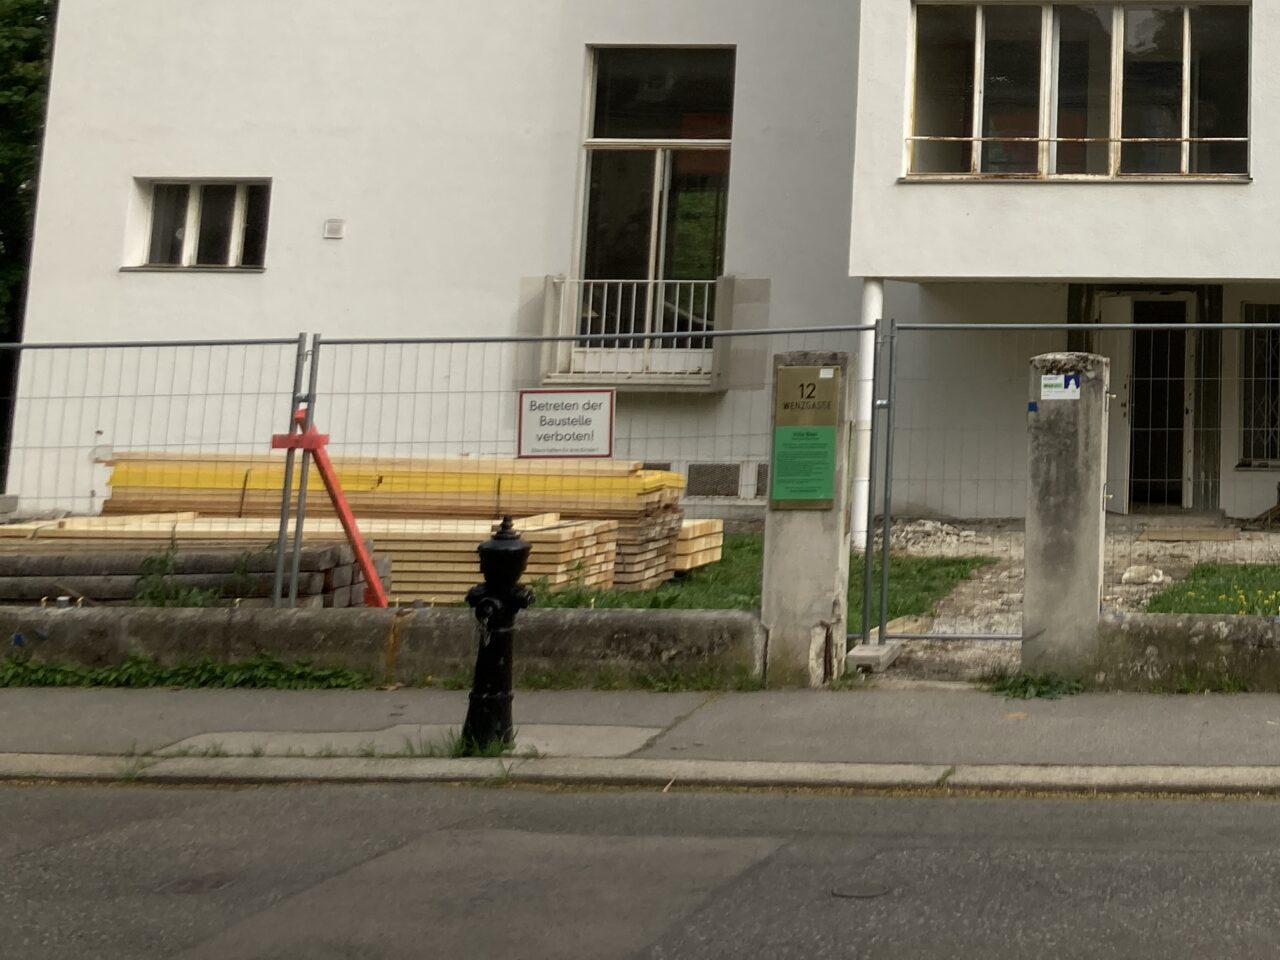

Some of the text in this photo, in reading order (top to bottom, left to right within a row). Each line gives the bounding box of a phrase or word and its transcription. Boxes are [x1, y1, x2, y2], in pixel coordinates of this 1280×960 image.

[799, 382, 816, 399] 12
[529, 400, 603, 411] Betreten der
[783, 400, 832, 410] WENZGASSE
[539, 415, 593, 426] Baustelle
[536, 429, 595, 441] verboten!
